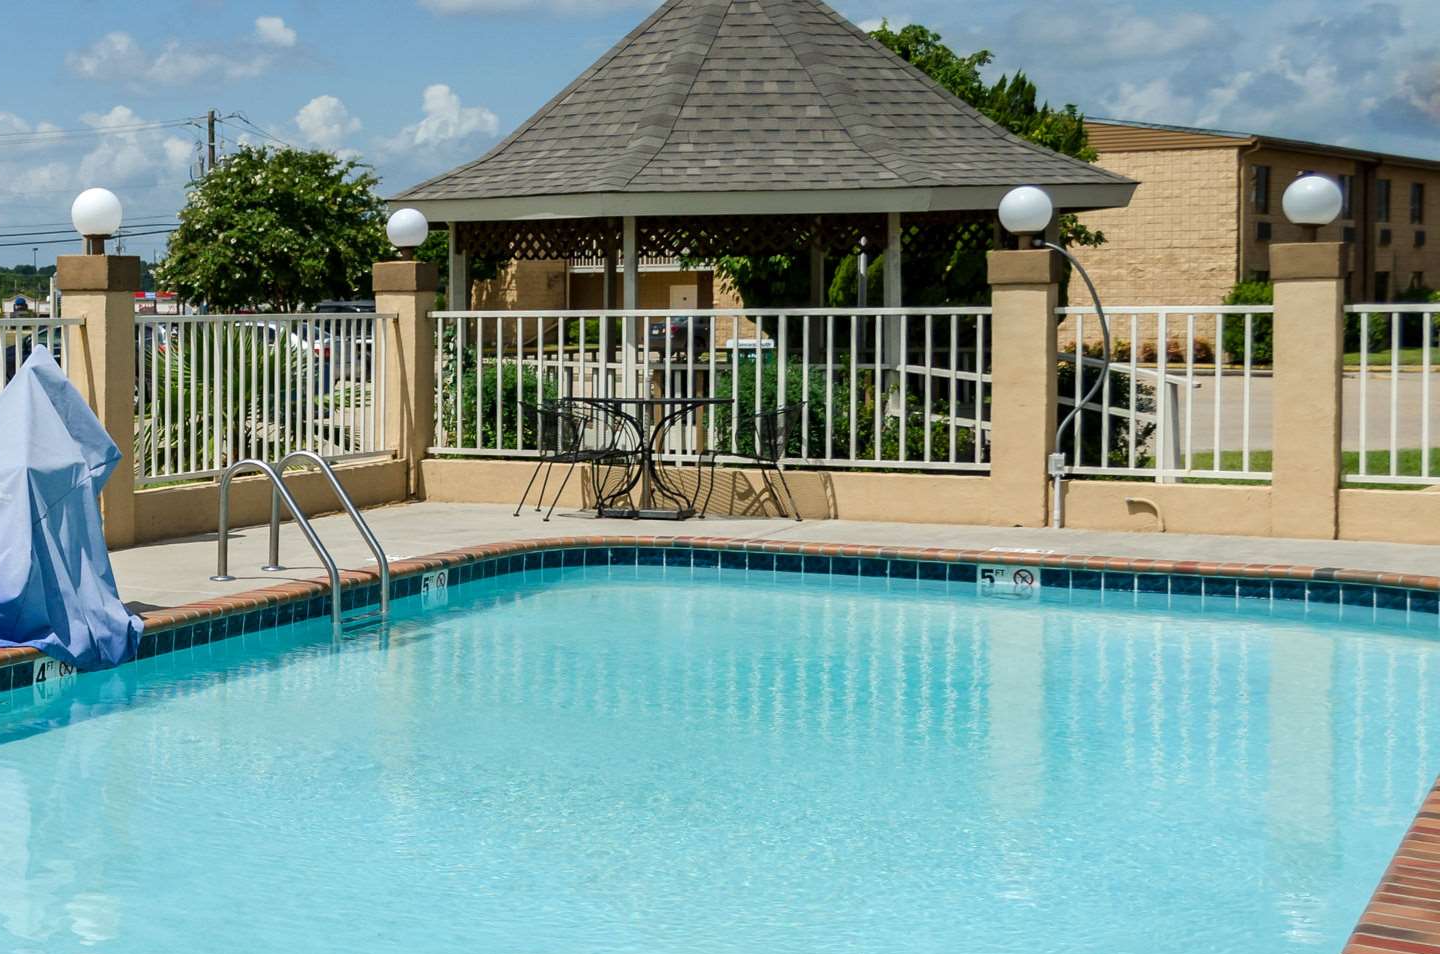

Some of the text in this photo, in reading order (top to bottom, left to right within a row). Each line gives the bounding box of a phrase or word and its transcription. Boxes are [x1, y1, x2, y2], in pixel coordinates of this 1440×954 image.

[423, 576, 430, 592] 5
[981, 568, 995, 584] 5
[36, 661, 55, 682] 4 FT
